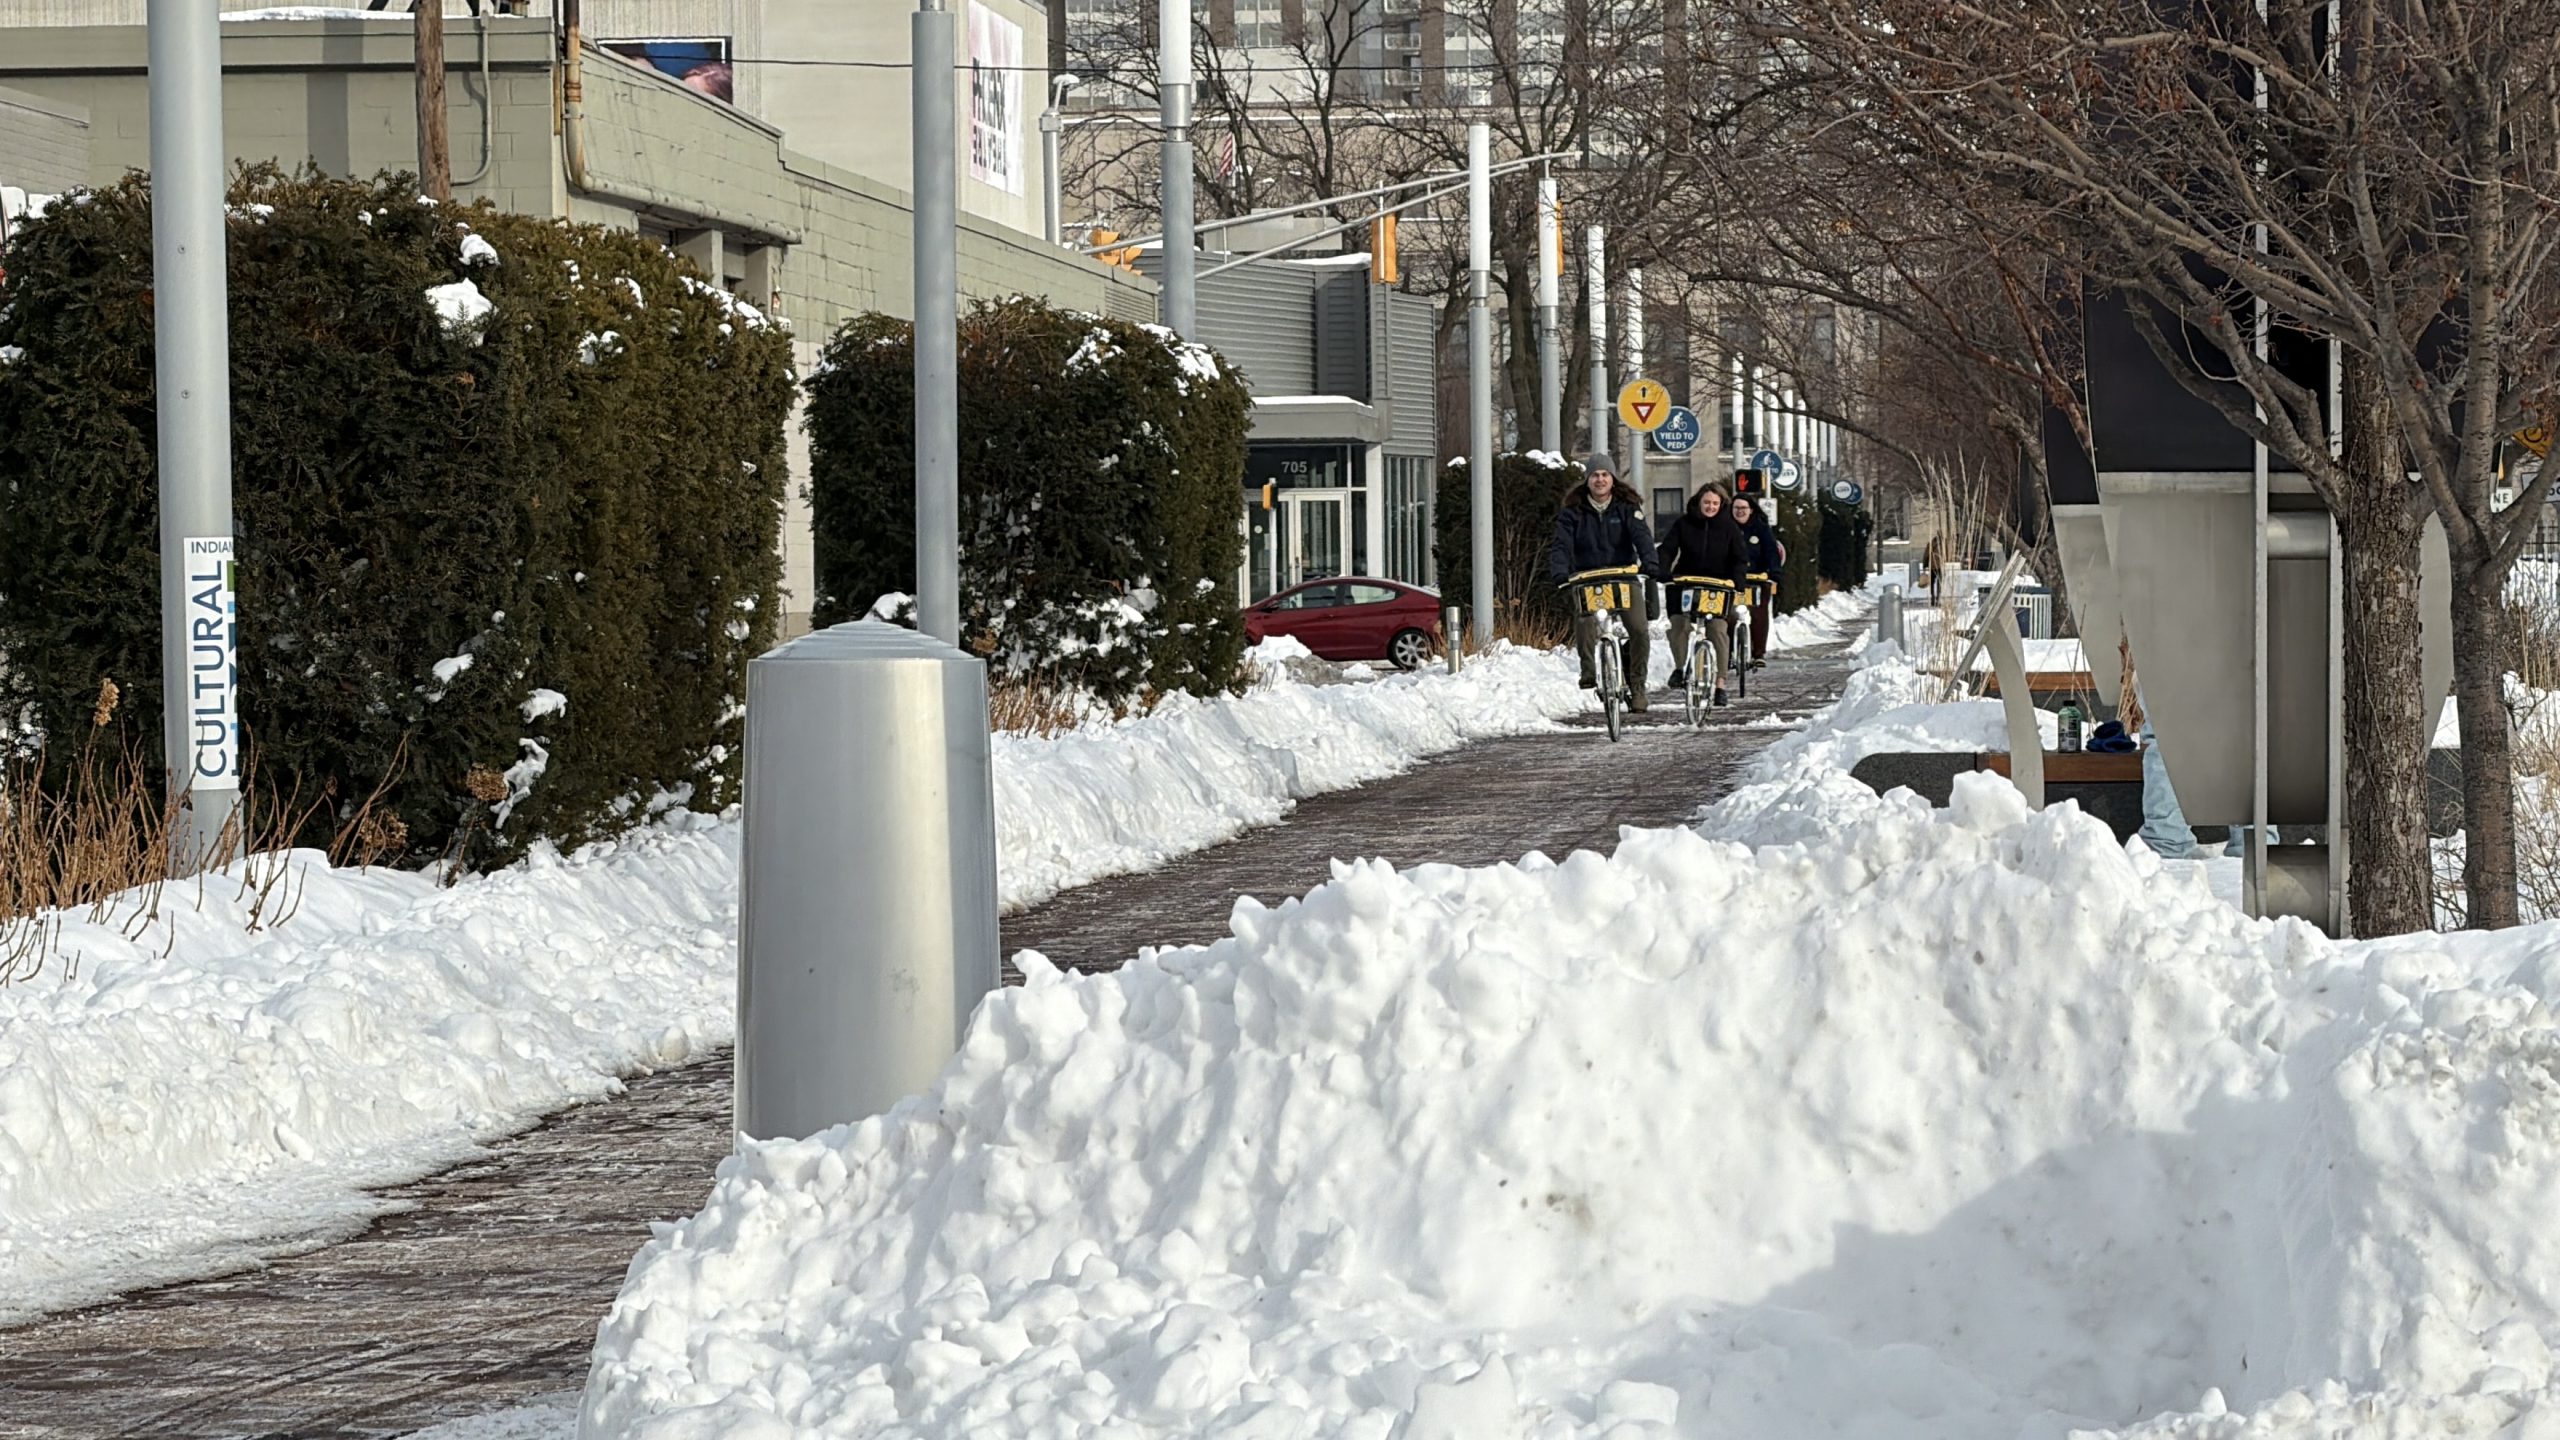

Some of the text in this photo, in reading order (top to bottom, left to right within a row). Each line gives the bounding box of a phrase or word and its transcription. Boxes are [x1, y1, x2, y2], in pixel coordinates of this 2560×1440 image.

[1660, 432, 1694, 440] YIELD TO
[1666, 441, 1687, 449] PEDS
[1281, 461, 1308, 474] 705
[191, 560, 226, 777] CULTURAL
